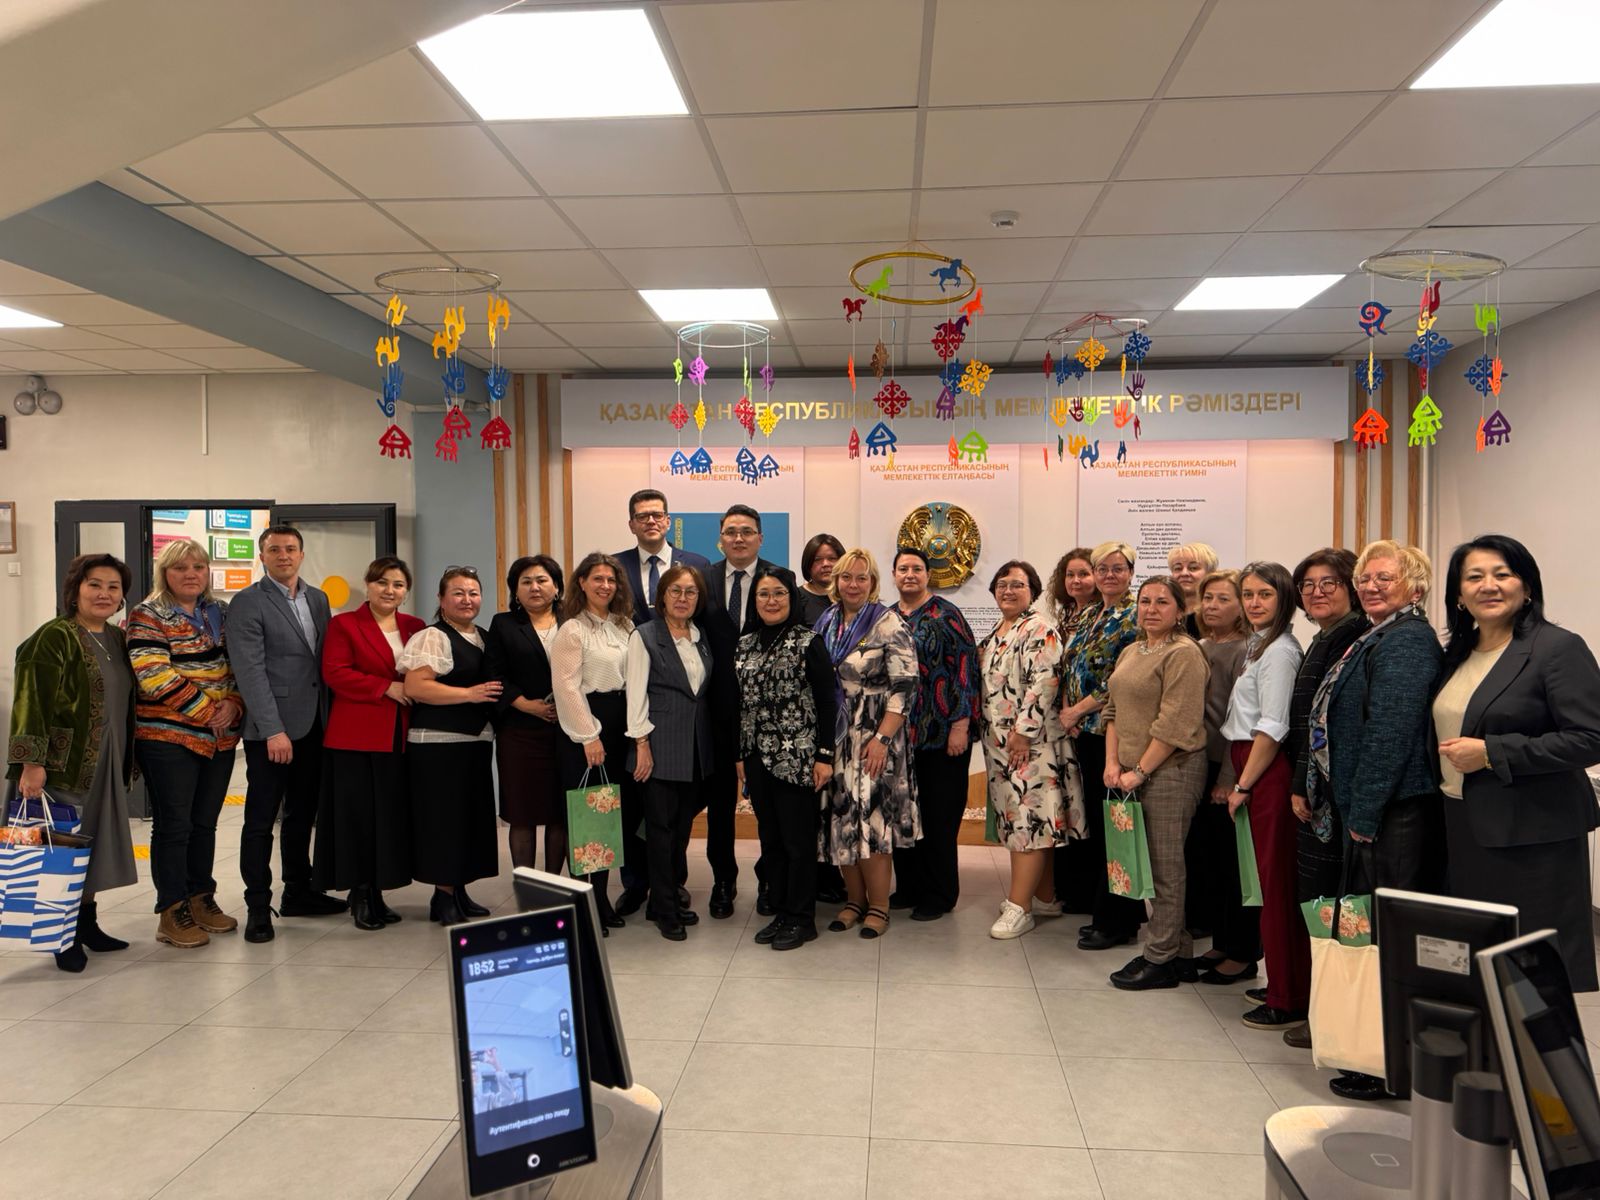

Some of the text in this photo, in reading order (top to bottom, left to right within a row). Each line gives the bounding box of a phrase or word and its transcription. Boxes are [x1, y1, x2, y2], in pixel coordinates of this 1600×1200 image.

[600, 402, 732, 424] ҚАЗАҚАН
[1169, 392, 1302, 415] РӘМІЗДЕРІ
[1090, 459, 1236, 470] АЗАҚСТАН РЕСПУБЛИКАСЫНЫҢ
[690, 473, 744, 481] МЕМЛЕКЕТТІ
[884, 472, 995, 481] МЕМЛЕКЕТТІК ЕЛТАҢБАСЫ
[1118, 468, 1207, 478] МЕМЛЕКЕТТІК ГИМНІ
